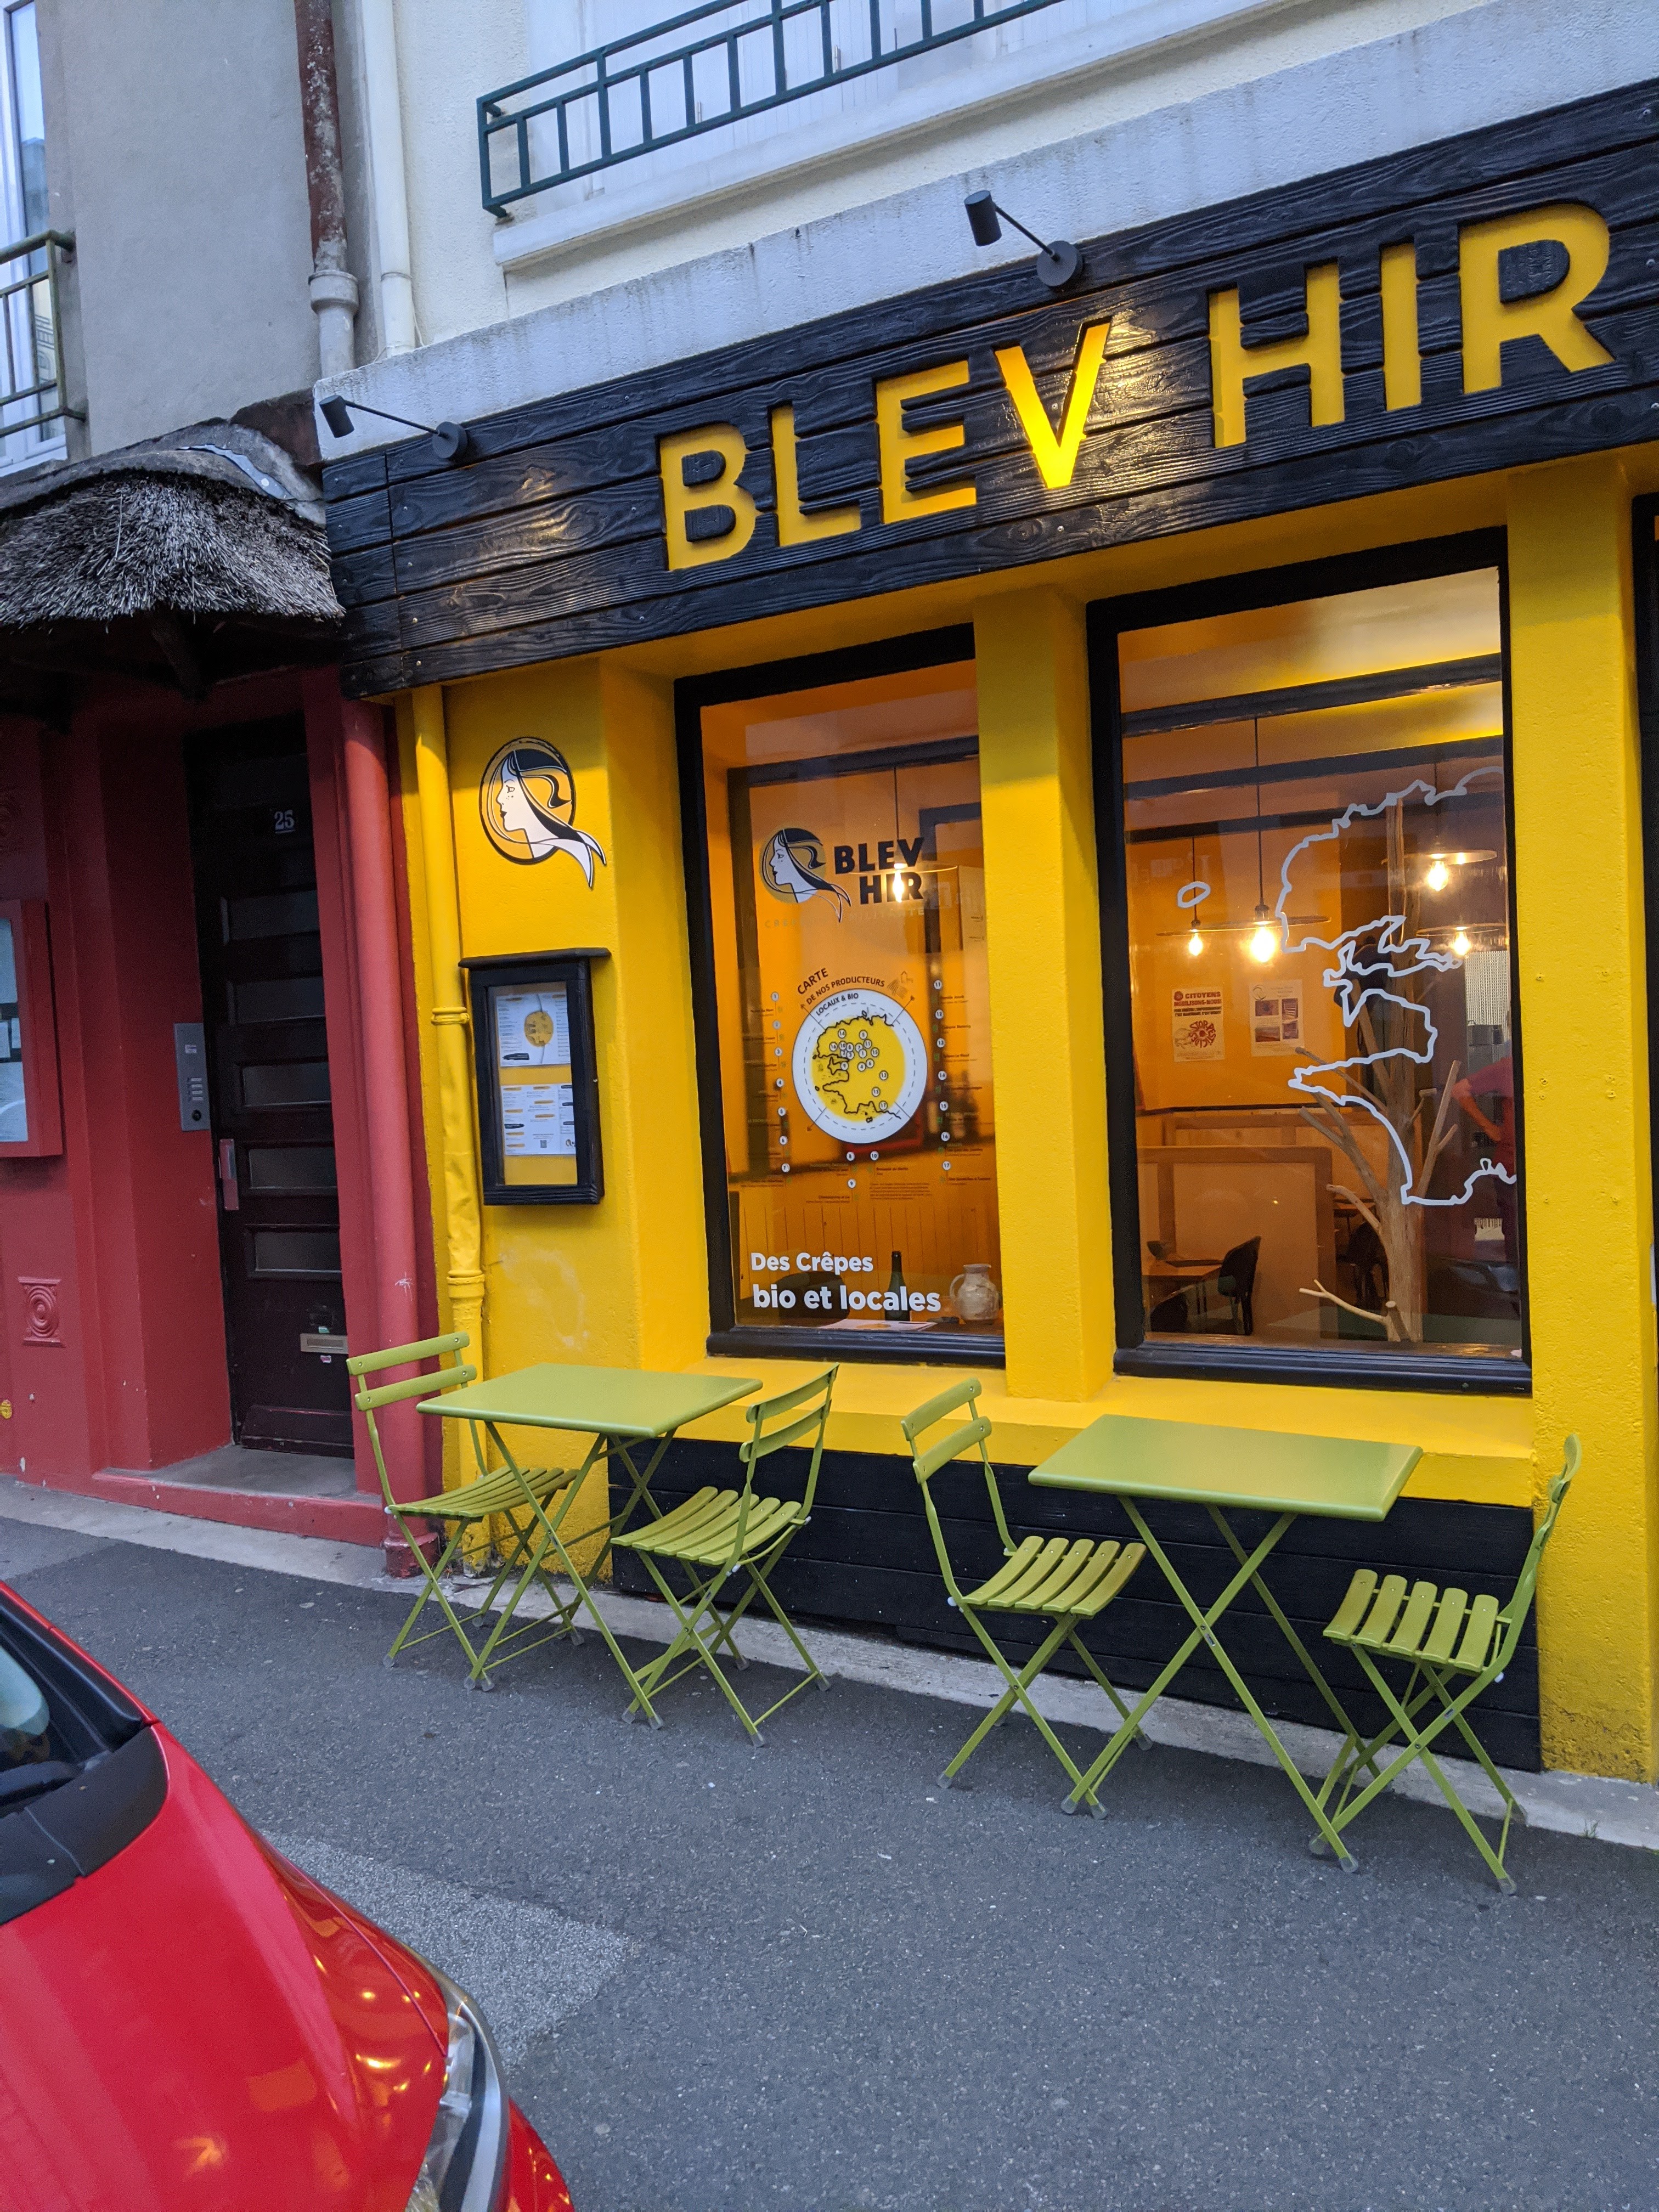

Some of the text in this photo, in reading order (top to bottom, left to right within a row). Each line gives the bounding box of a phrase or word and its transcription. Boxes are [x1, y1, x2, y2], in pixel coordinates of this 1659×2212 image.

[659, 204, 1616, 571] BLEV HIR
[274, 810, 295, 830] 25
[834, 837, 924, 874] BLEV
[859, 871, 923, 905] HIR
[797, 967, 828, 995] CARTE
[806, 976, 885, 1005] DE NOS PRODUCTEURS
[816, 997, 840, 1016] LOCAUX
[751, 1251, 873, 1275] Des Crêpes
[753, 1284, 941, 1312] bio et locales
